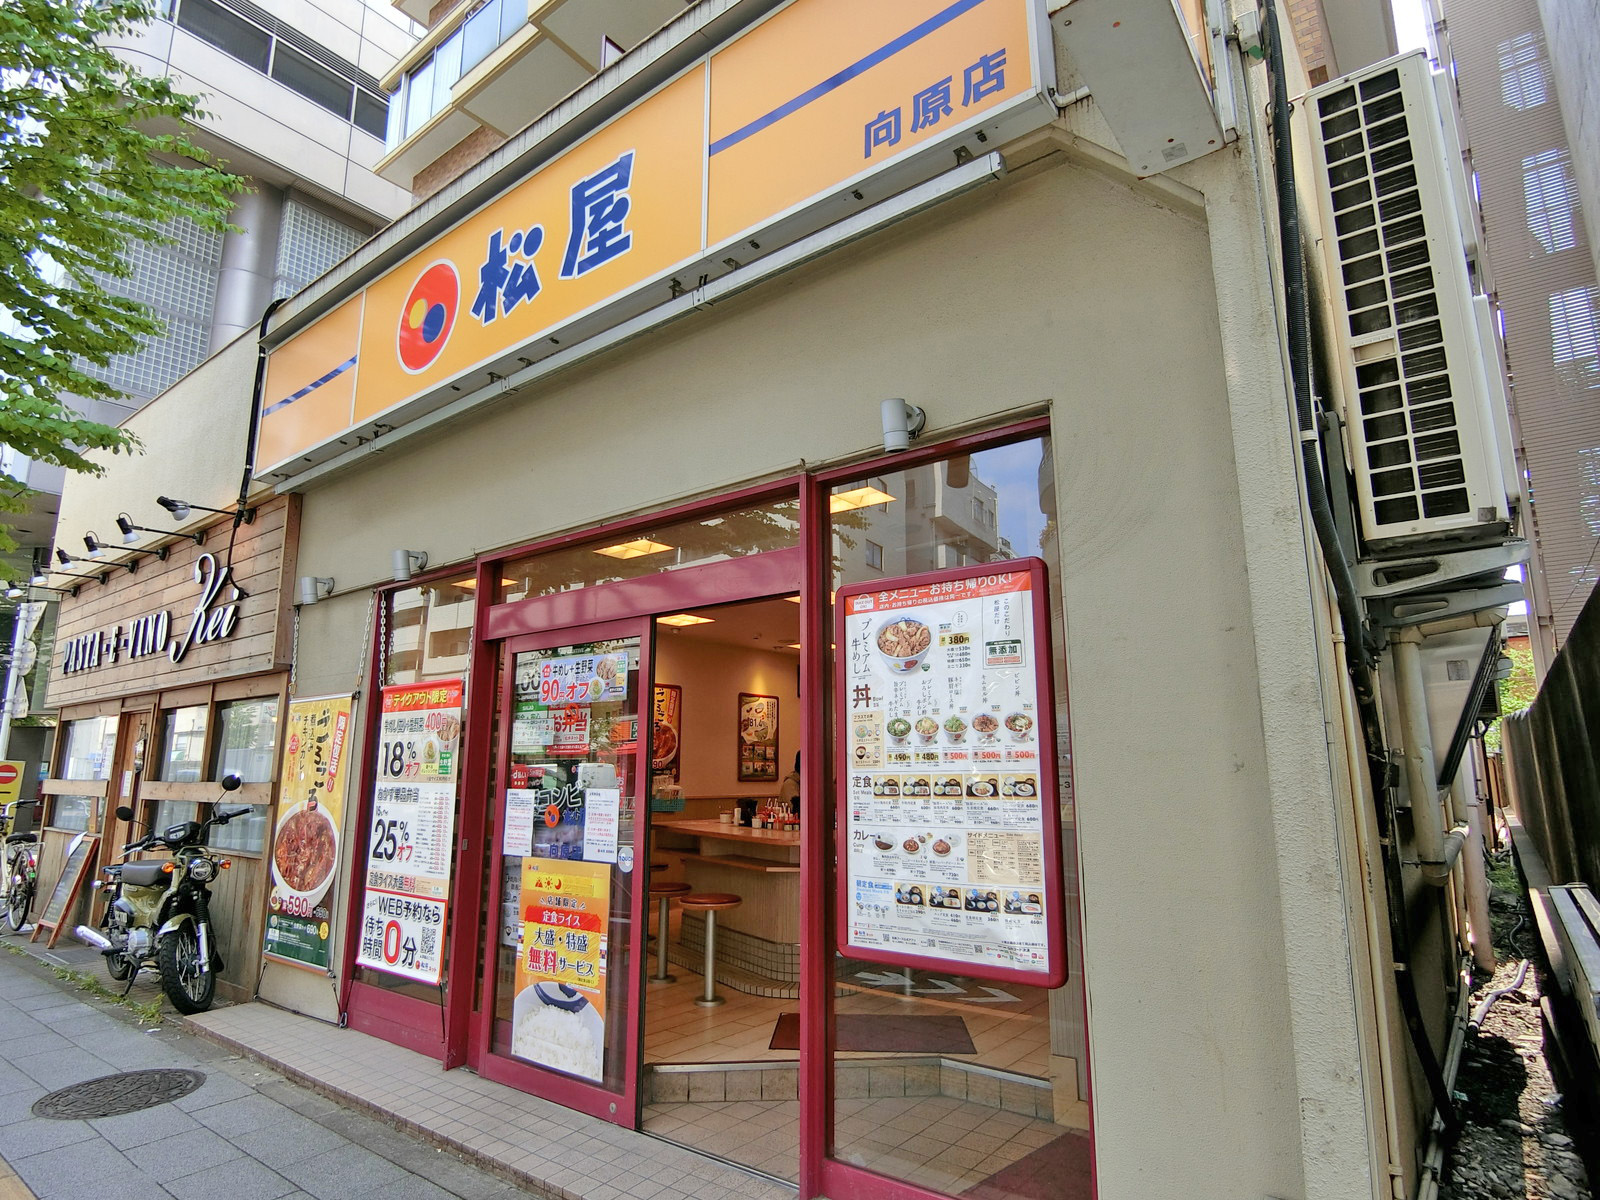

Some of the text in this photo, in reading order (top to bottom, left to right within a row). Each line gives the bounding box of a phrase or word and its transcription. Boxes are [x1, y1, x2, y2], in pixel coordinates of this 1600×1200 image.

[863, 48, 1007, 159] 向原店
[470, 149, 636, 327] 松屋
[861, 618, 873, 673] プレミアム
[948, 635, 970, 645] 380円
[851, 637, 862, 675] 牛めし
[988, 645, 1018, 655] 無添加
[393, 689, 448, 707] テイクアウト限定
[541, 679, 590, 703] 90円オフ
[853, 683, 872, 709] 丼
[950, 752, 968, 760] 500円
[981, 752, 1001, 760] 500円
[1014, 751, 1035, 759] 500円
[404, 761, 421, 777] オフ
[852, 775, 872, 788] 定食
[853, 829, 876, 841] カレー
[396, 843, 413, 862] オフ
[378, 895, 441, 924] WEB予約なら
[547, 895, 578, 909] 店舗限定
[365, 914, 384, 937] 待ち
[542, 910, 581, 927] 定食ライス
[362, 937, 383, 960] 時間
[533, 927, 589, 953] 大盛・特盛
